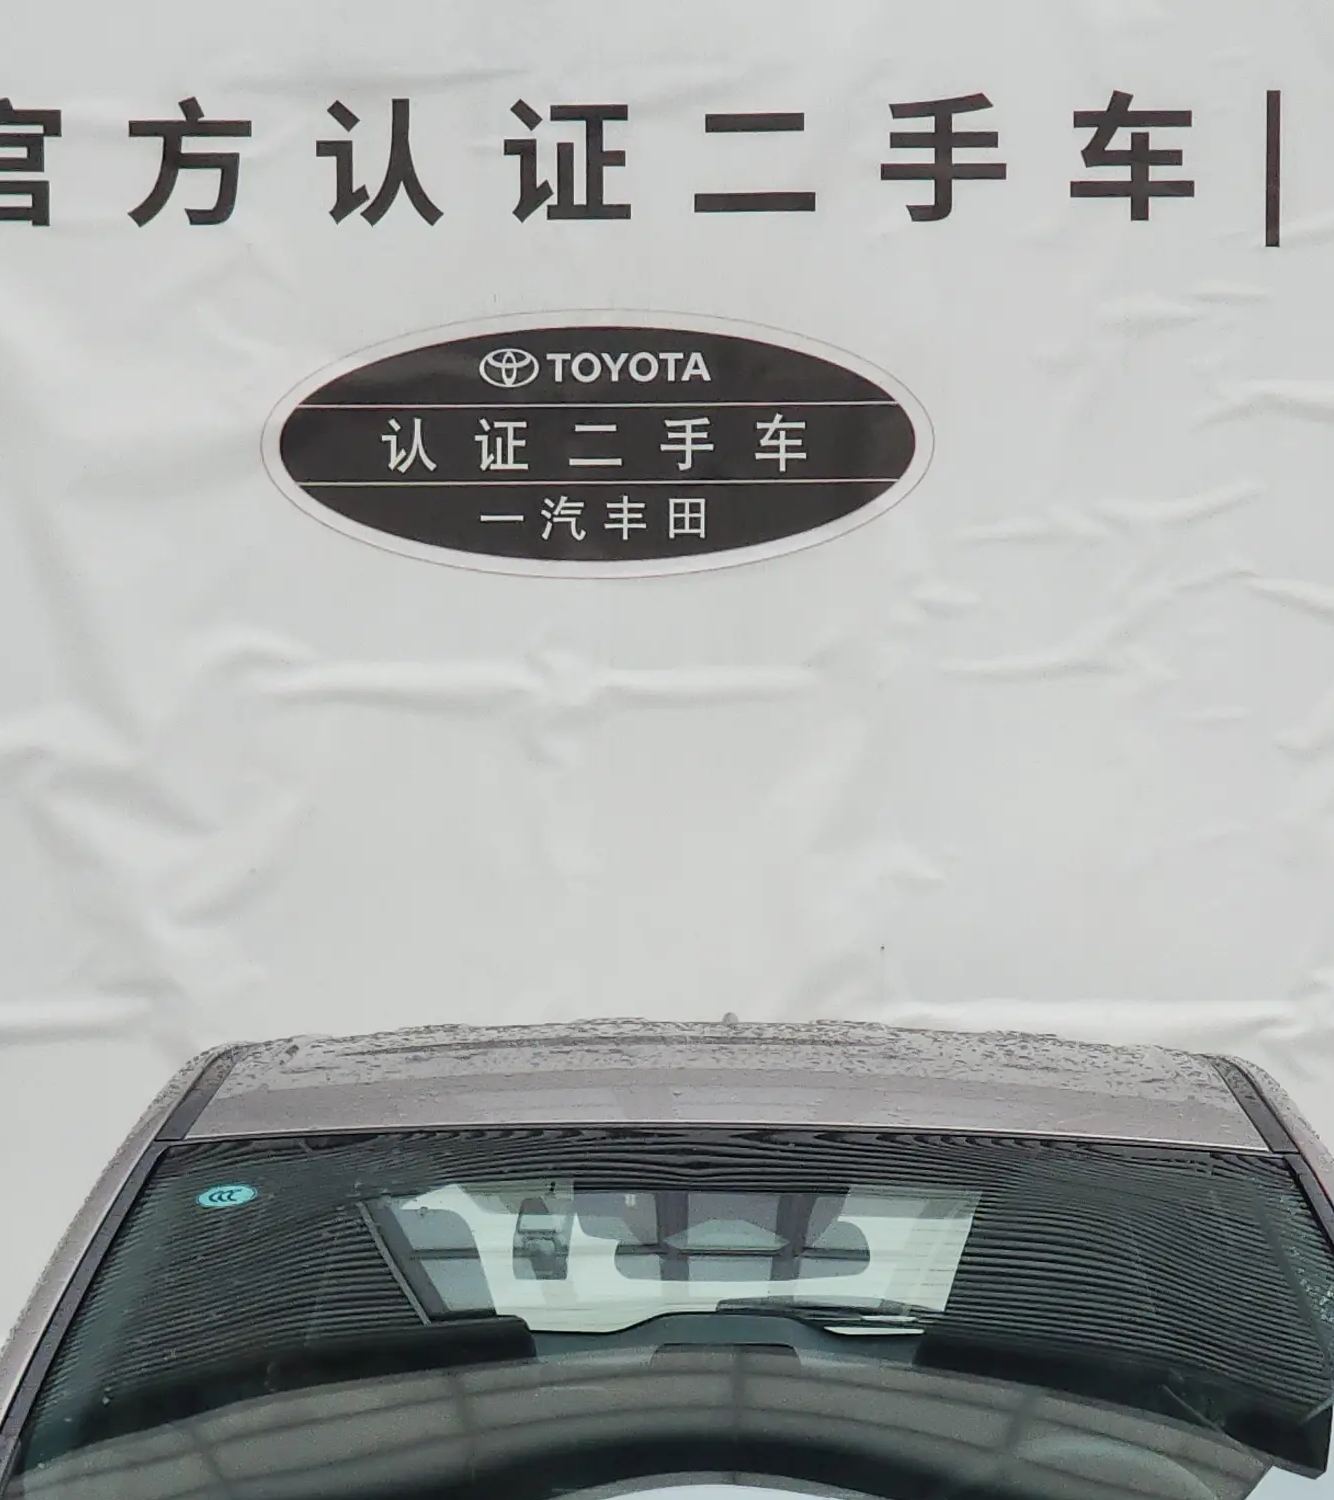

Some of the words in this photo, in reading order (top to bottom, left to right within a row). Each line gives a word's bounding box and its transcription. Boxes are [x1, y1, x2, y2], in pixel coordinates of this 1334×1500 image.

[546, 351, 712, 384] TOYOTA
[381, 412, 808, 474] 认证二手车
[479, 495, 707, 541] 一汽丰田
